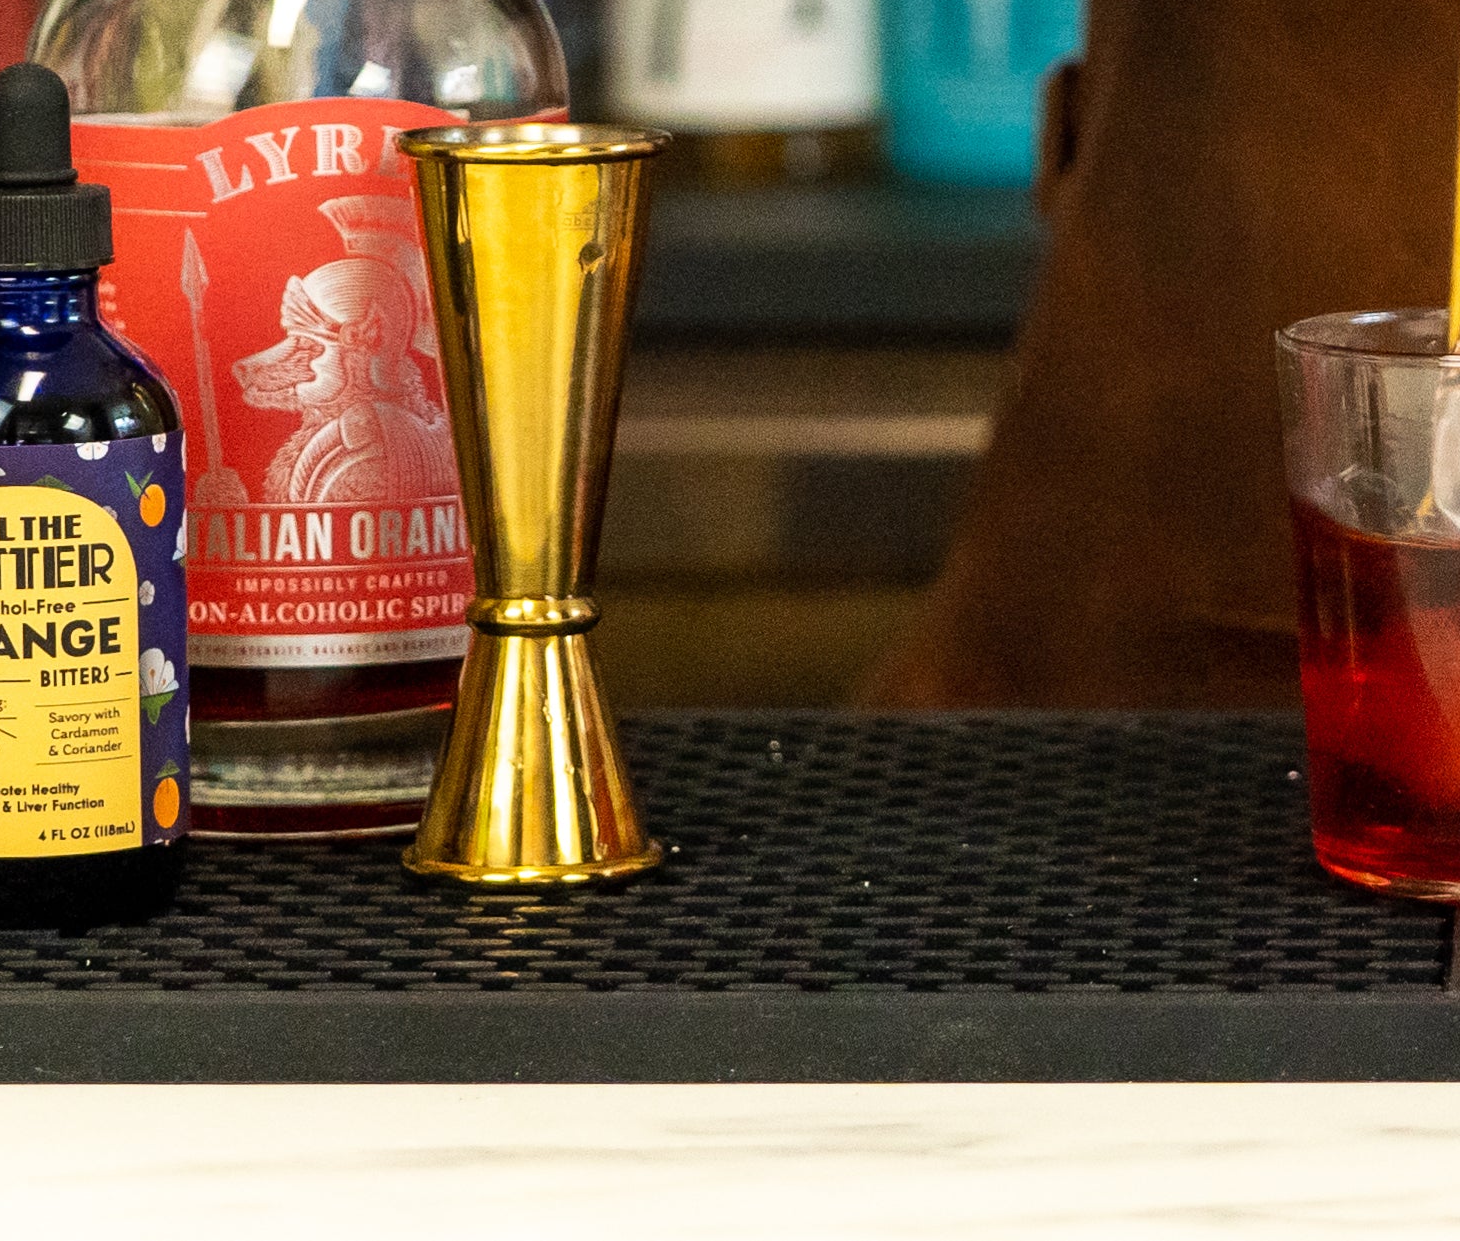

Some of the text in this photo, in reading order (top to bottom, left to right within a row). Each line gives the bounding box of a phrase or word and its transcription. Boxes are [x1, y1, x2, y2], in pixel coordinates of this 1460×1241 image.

[21, 514, 81, 539] THE
[350, 505, 468, 560] ORAN
[235, 569, 449, 593] IMPOSSIBLY CRAFTED
[41, 666, 109, 687] BITTERS
[49, 707, 120, 726] Savory with
[51, 725, 118, 739] Cardamom
[49, 741, 122, 756] & Coriander
[31, 783, 80, 798] Healthy
[3, 800, 12, 813] &
[17, 800, 47, 813] Liver
[52, 797, 104, 812] Function
[38, 822, 135, 841] 4 FL OZ (118mL)
